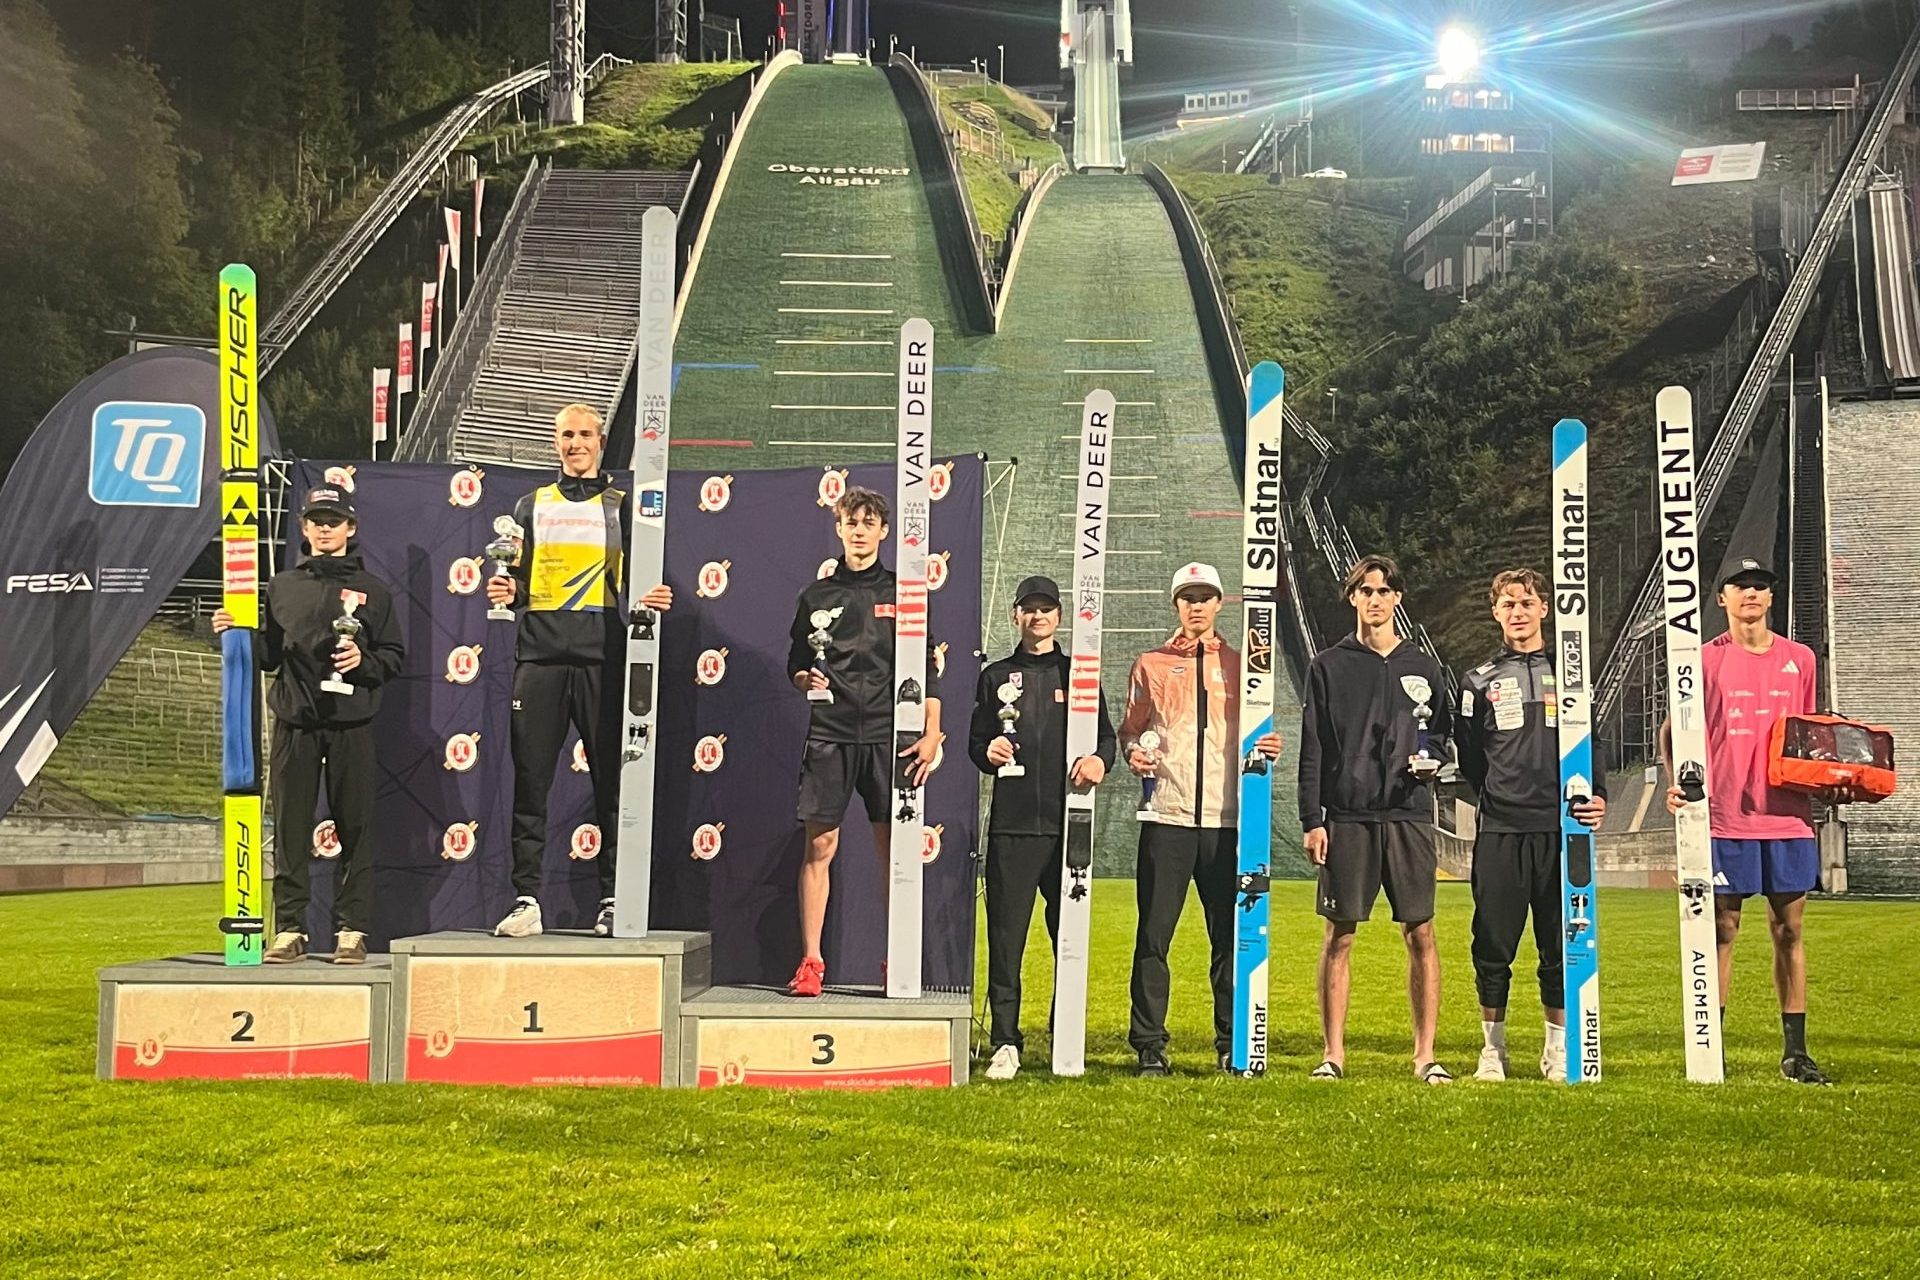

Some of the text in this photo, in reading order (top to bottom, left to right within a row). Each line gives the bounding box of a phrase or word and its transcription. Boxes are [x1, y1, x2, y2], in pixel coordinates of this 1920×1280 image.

[767, 163, 911, 176] Oberstdorf
[800, 175, 881, 187] Allgäu
[646, 234, 668, 371] VAN DEER
[229, 287, 249, 470] FISCHER
[643, 393, 667, 408] VAN DEER
[905, 341, 927, 487] VAN DEER
[111, 418, 187, 493] TQ
[1082, 411, 1109, 560] VAN DEER
[903, 507, 927, 515] DEER
[1247, 443, 1279, 571] Slatnar
[1661, 421, 1699, 635] AUGMENT
[6, 571, 94, 594] FESA
[1556, 488, 1586, 616] Slatnar
[1677, 664, 1694, 704] SCA
[236, 820, 250, 952] FISCHR
[230, 1010, 255, 1042] 2
[523, 1001, 544, 1033] 1
[1692, 950, 1710, 1049] AUGMENT
[811, 1033, 835, 1065] 3
[1250, 1003, 1266, 1074] Slatnar
[1583, 1009, 1599, 1078] Slatnar
